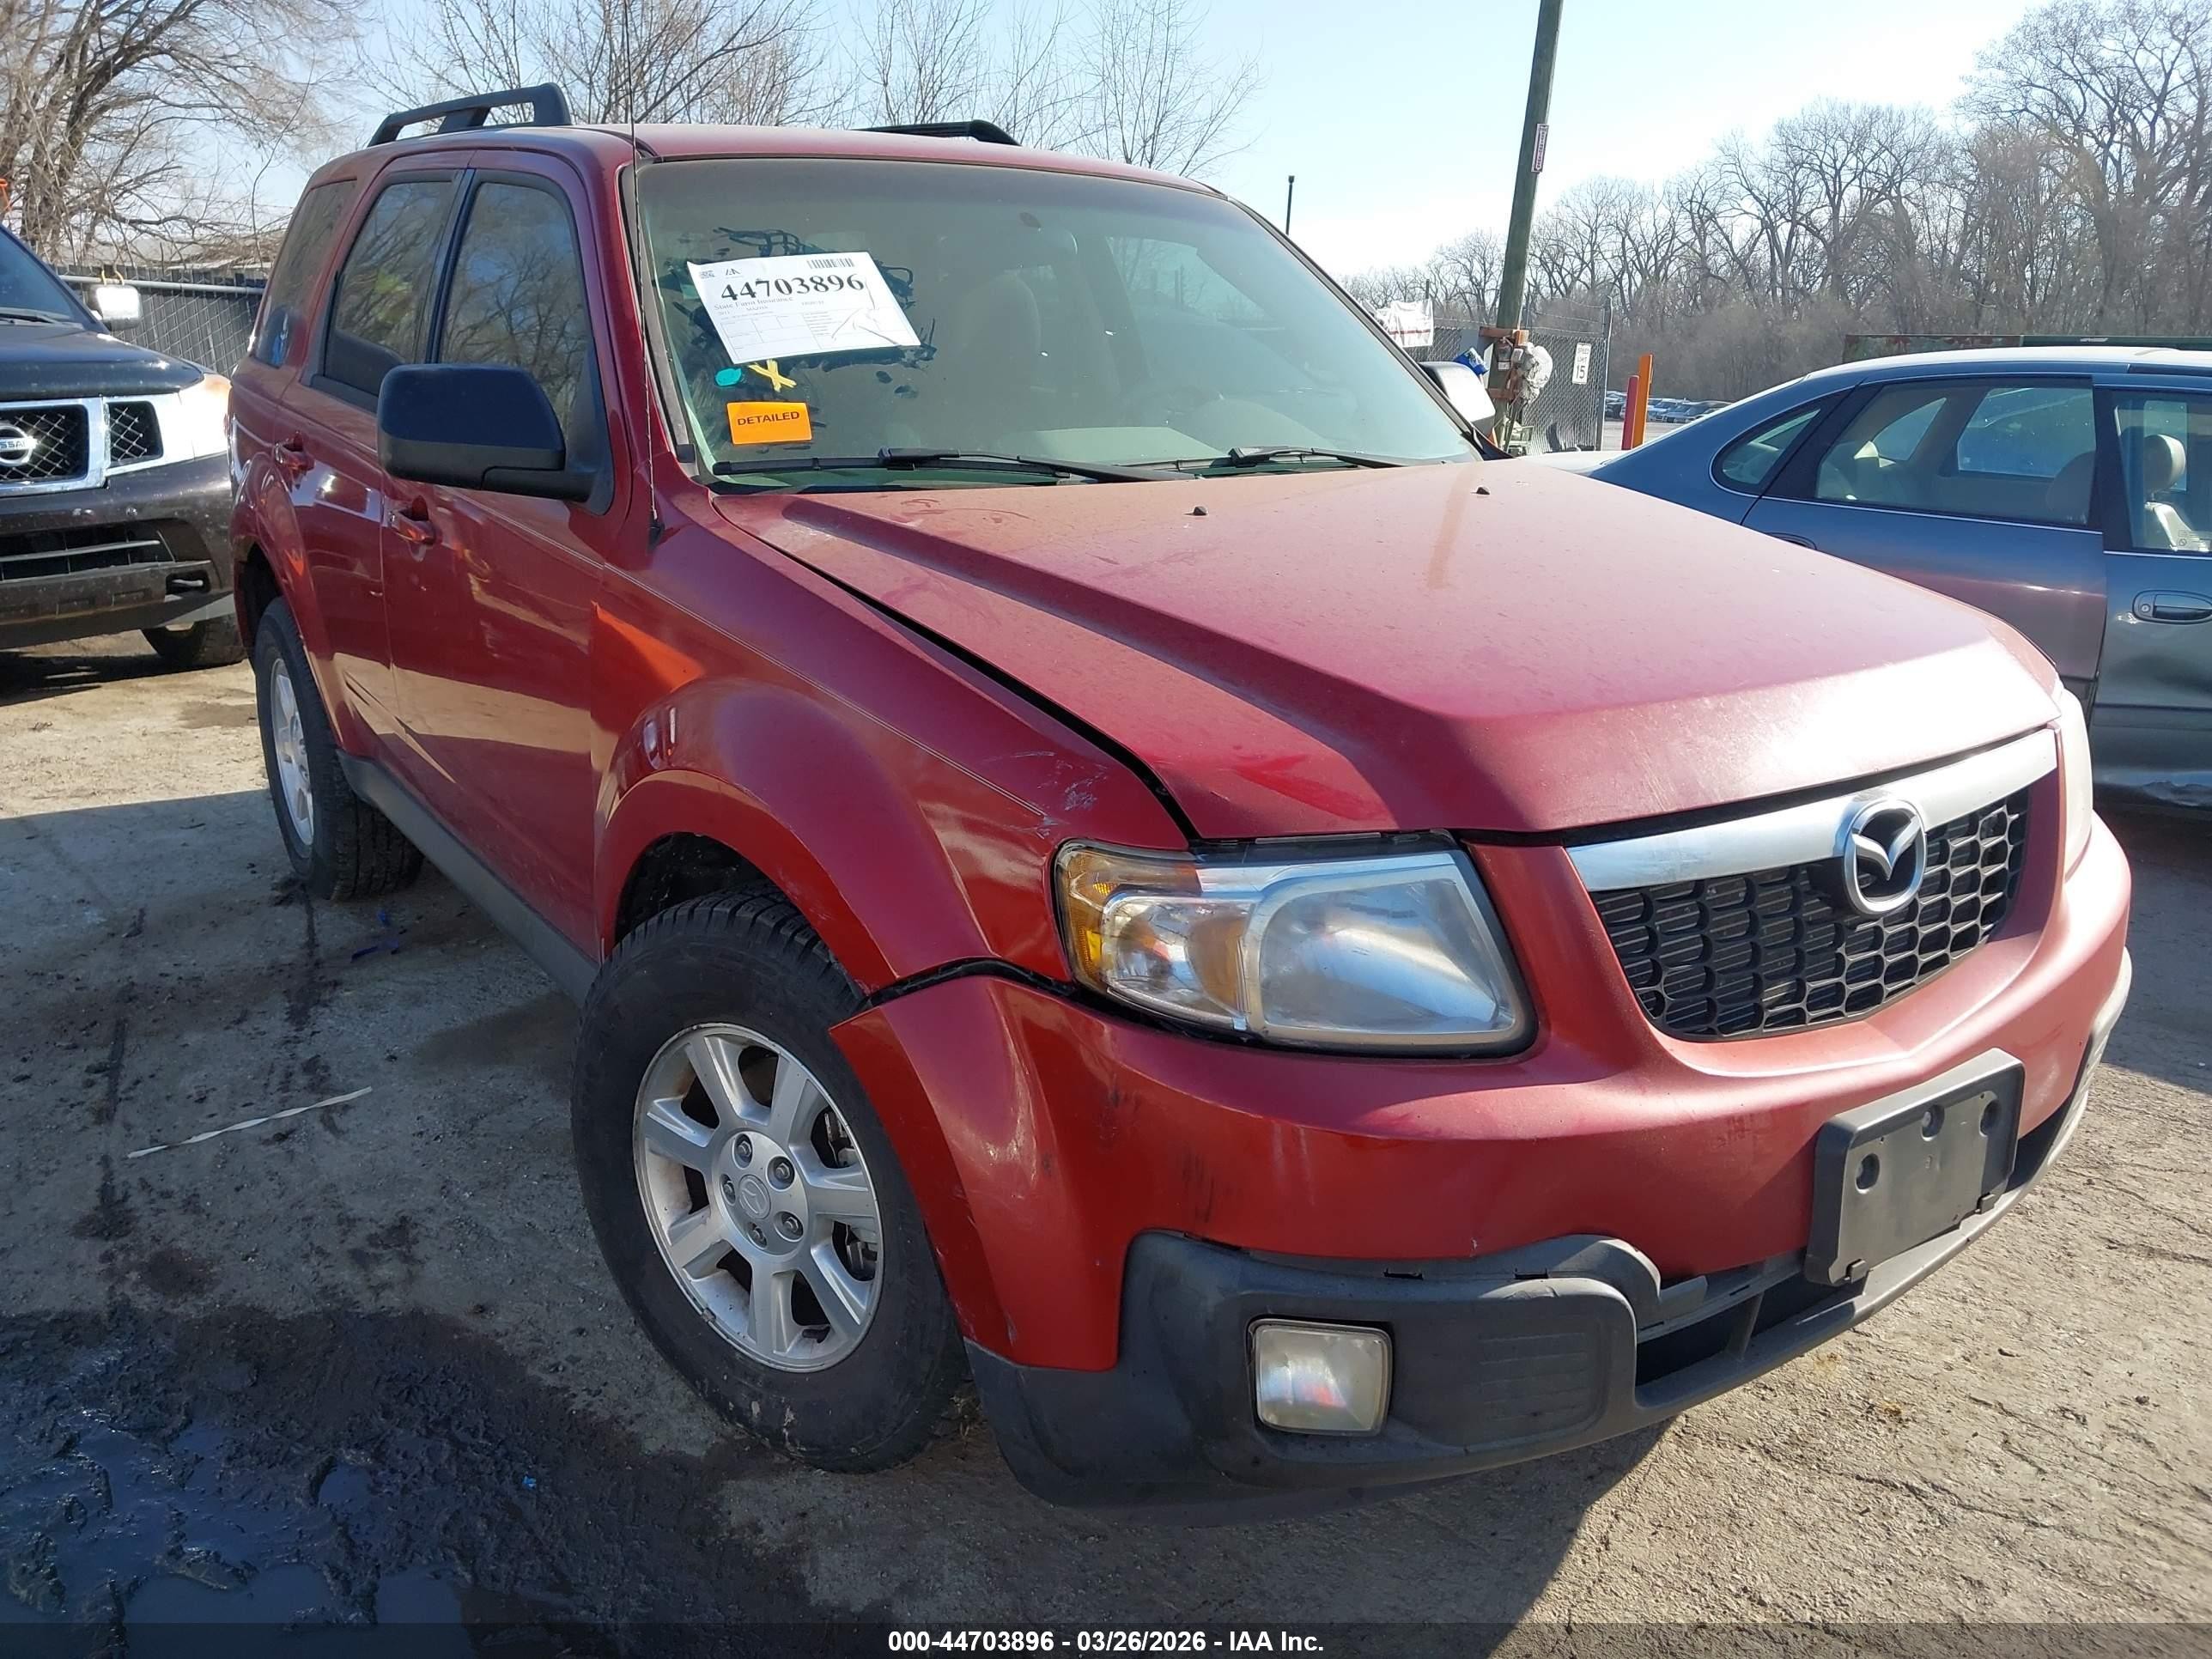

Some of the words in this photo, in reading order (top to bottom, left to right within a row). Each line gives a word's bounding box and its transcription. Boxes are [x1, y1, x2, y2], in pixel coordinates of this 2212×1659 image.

[721, 273, 865, 301] 44703896
[1576, 365, 1586, 380] 15
[737, 410, 800, 426] DETAILED
